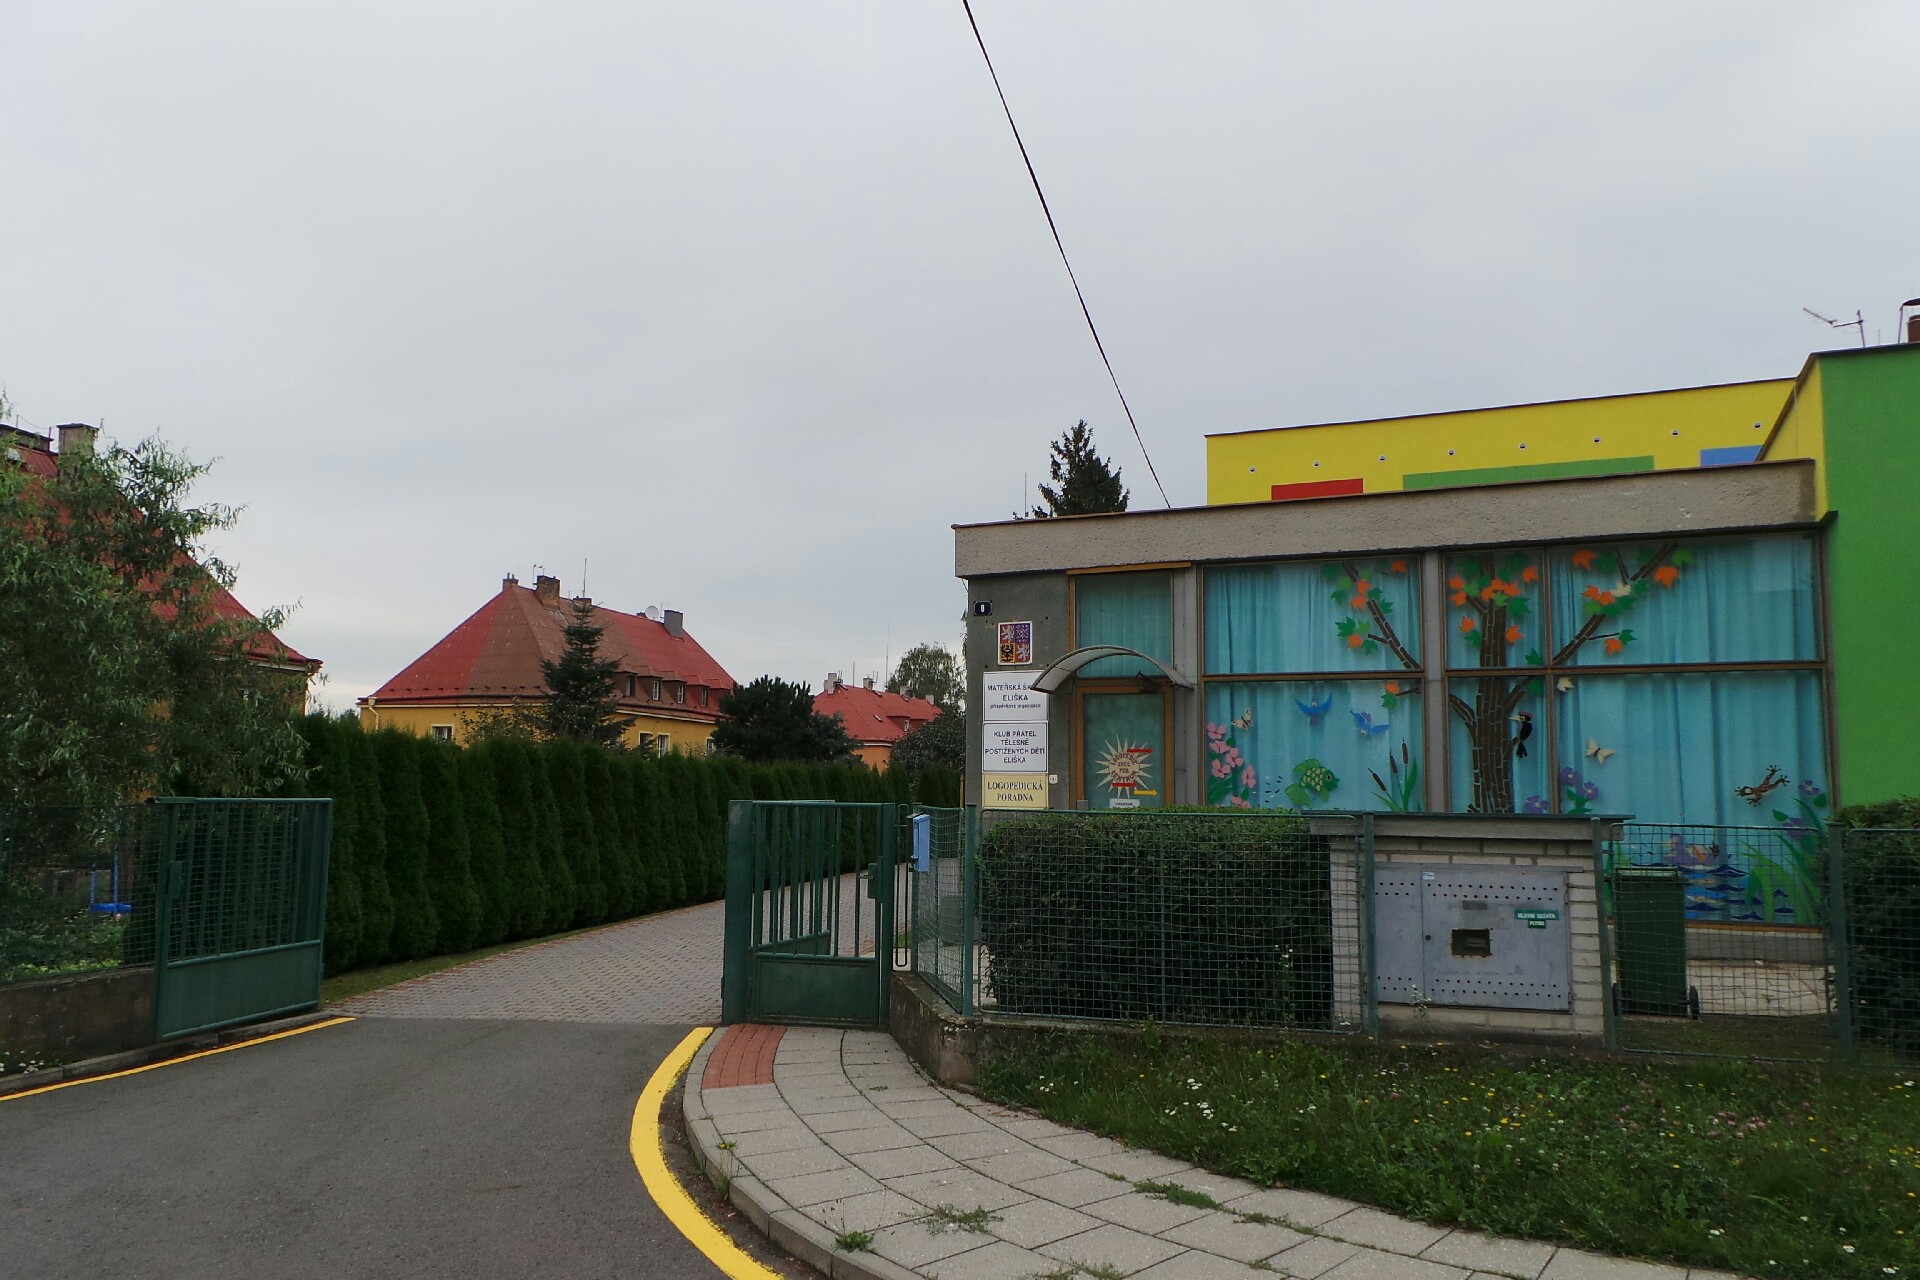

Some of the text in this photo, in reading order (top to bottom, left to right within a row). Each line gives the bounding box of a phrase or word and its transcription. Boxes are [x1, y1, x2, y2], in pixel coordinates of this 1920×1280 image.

[980, 604, 985, 613] 8
[987, 683, 1021, 691] MATEŘSKÁ
[1002, 693, 1029, 702] ELIŠKA
[1012, 729, 1037, 737] PŘÁTEL
[984, 746, 1045, 755] POSTIŽENÝCH DĚTÍ
[1003, 756, 1026, 764] ELIŠKA
[987, 780, 1043, 791] LOGOPEDICKÁ
[997, 793, 1034, 802] PORADNA
